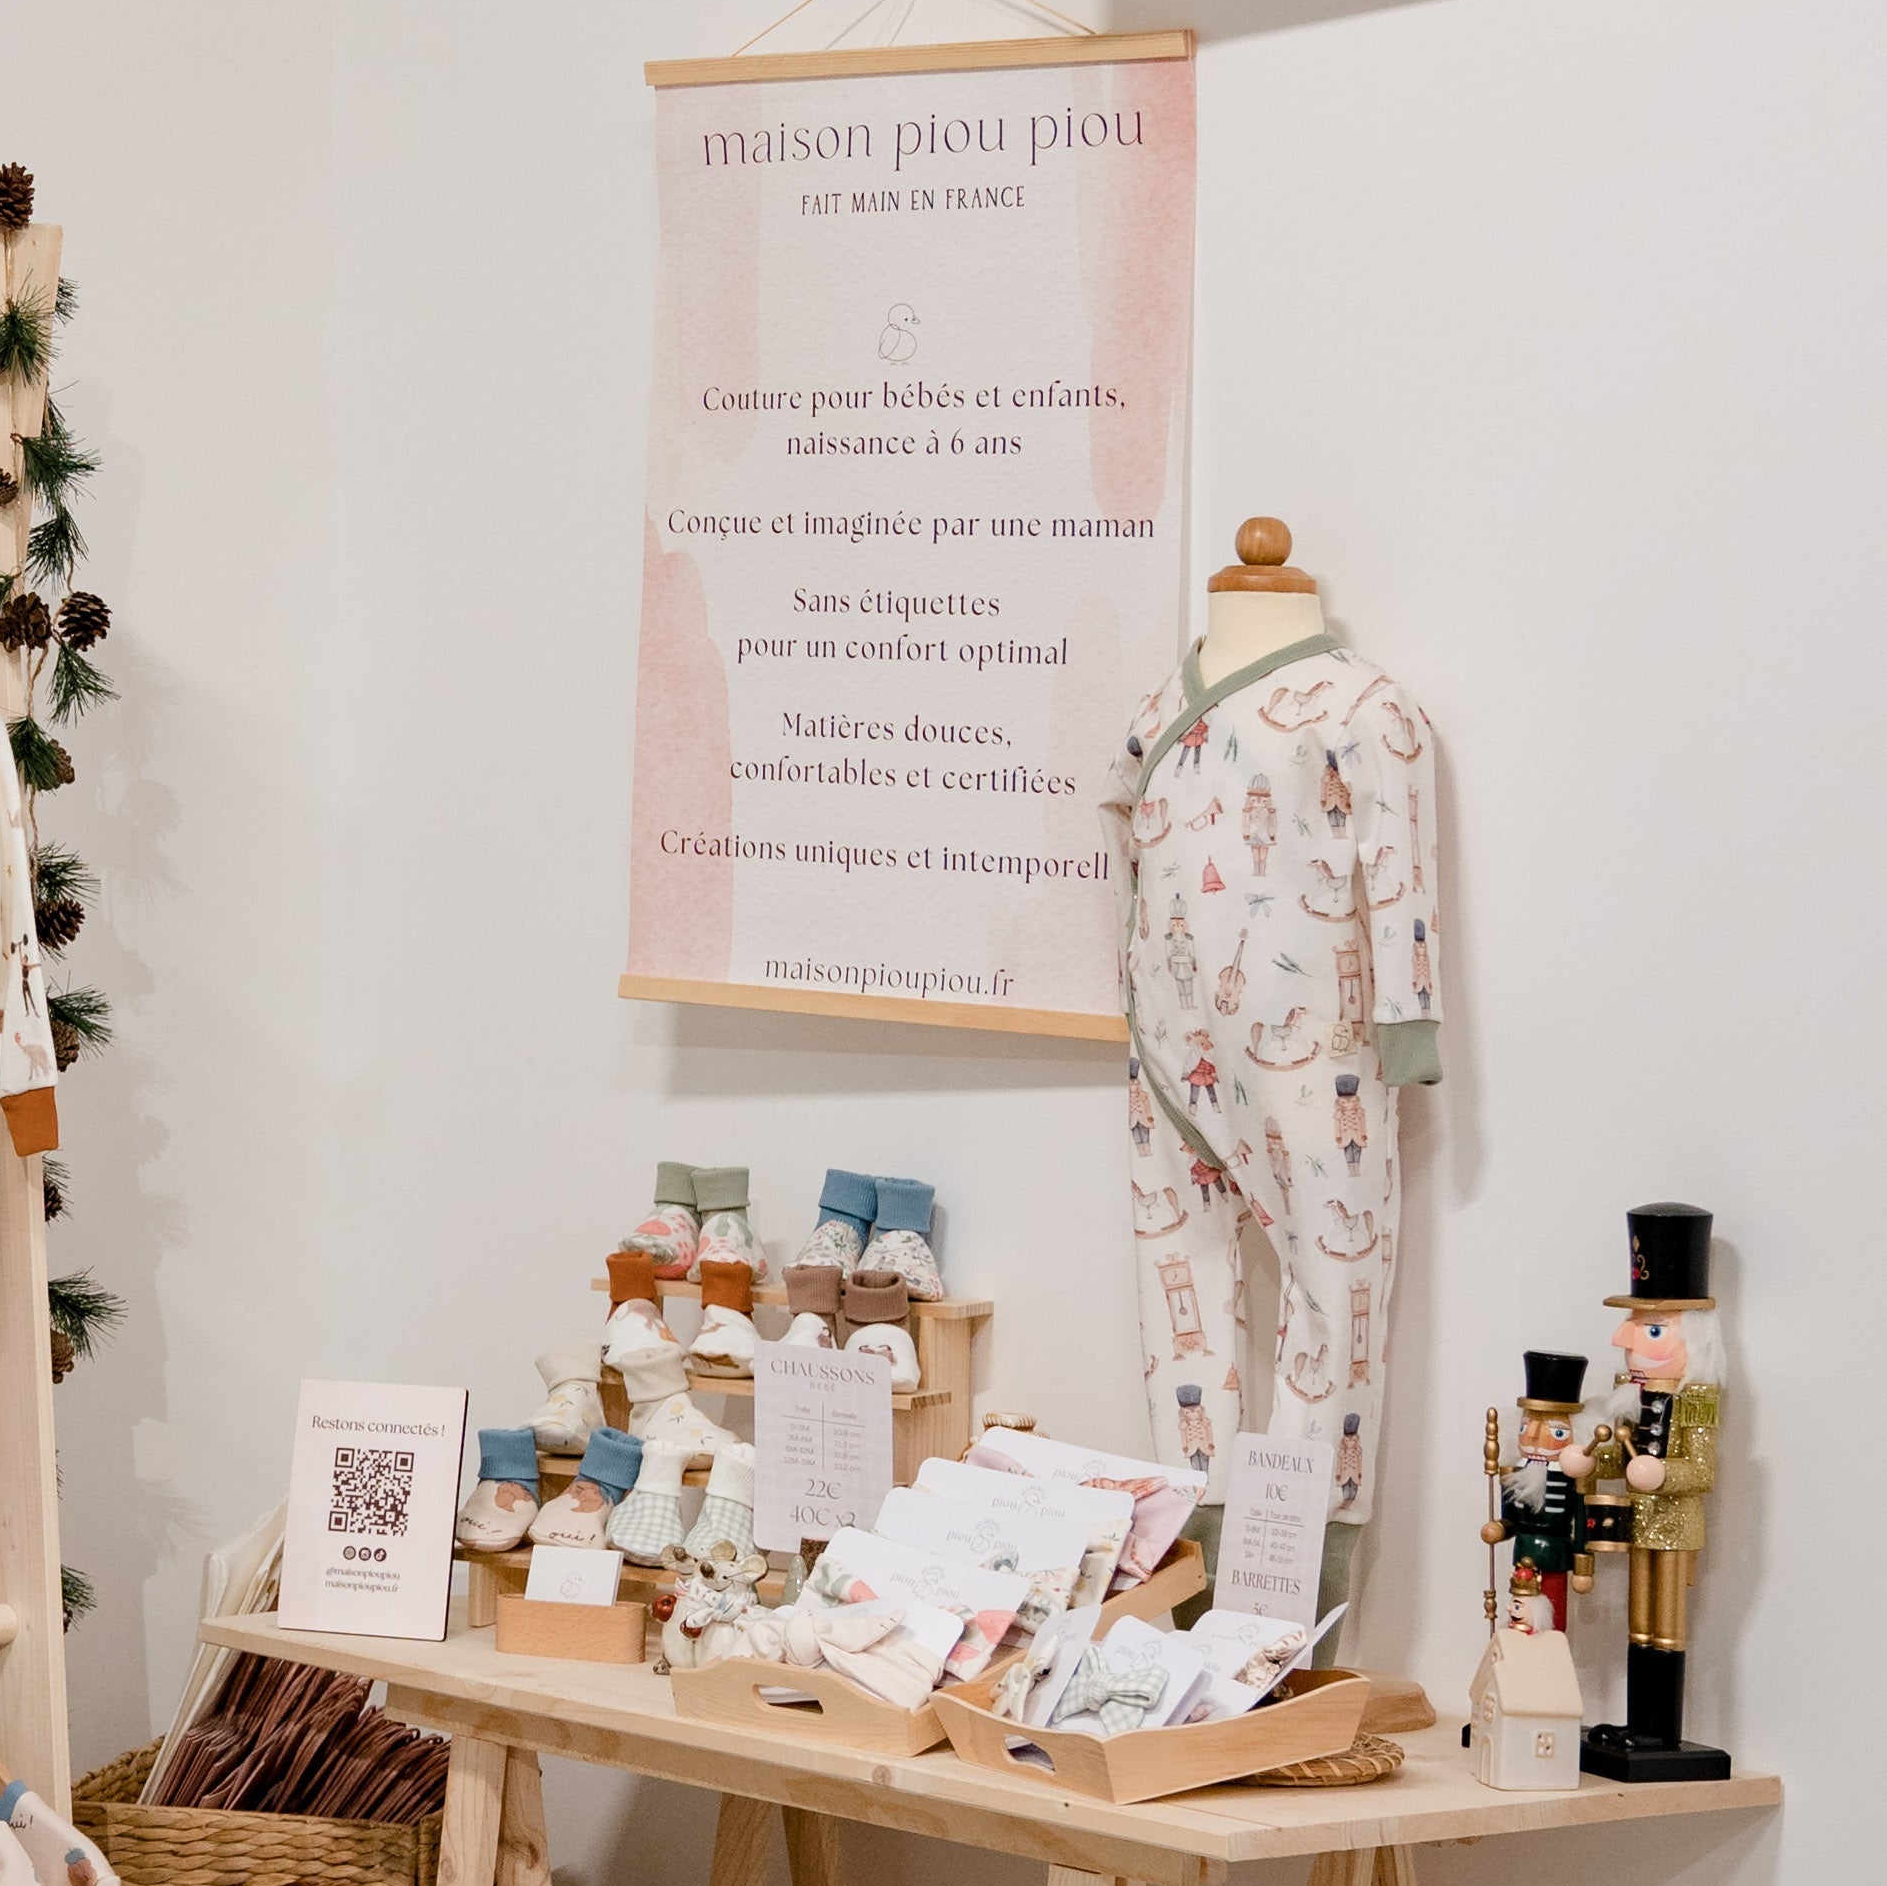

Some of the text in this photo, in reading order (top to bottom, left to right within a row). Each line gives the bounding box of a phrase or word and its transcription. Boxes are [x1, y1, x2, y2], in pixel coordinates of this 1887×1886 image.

[703, 106, 1144, 172] maison piou piou
[801, 185, 1025, 216] FAIT MAIN EN FRANCE
[703, 379, 1126, 418] Couture pour bébés et enfants,
[787, 427, 1022, 456] naissance à 6 ans
[668, 509, 1154, 545] Conçue et imaginée par une maman
[793, 587, 1000, 624] Sans étiquettes
[737, 633, 1067, 672] pour un confort optimal
[782, 712, 1012, 749] Matières douces,
[730, 755, 1076, 796] confortables et certifiées
[660, 829, 1109, 885] Créations uniques et intemporell
[765, 957, 1015, 999] maisonpioupiou.fr
[770, 1359, 875, 1386] CHAUSSONS
[312, 1415, 365, 1432] Restons
[367, 1421, 439, 1437] connectés
[1248, 1450, 1314, 1474] BANDEAUX
[804, 1478, 842, 1500] 22€
[991, 1496, 1017, 1510] piou
[1265, 1483, 1289, 1501] 10€
[946, 1530, 971, 1544] piou
[890, 1572, 916, 1586] piou
[1232, 1569, 1301, 1596] BARRETTES
